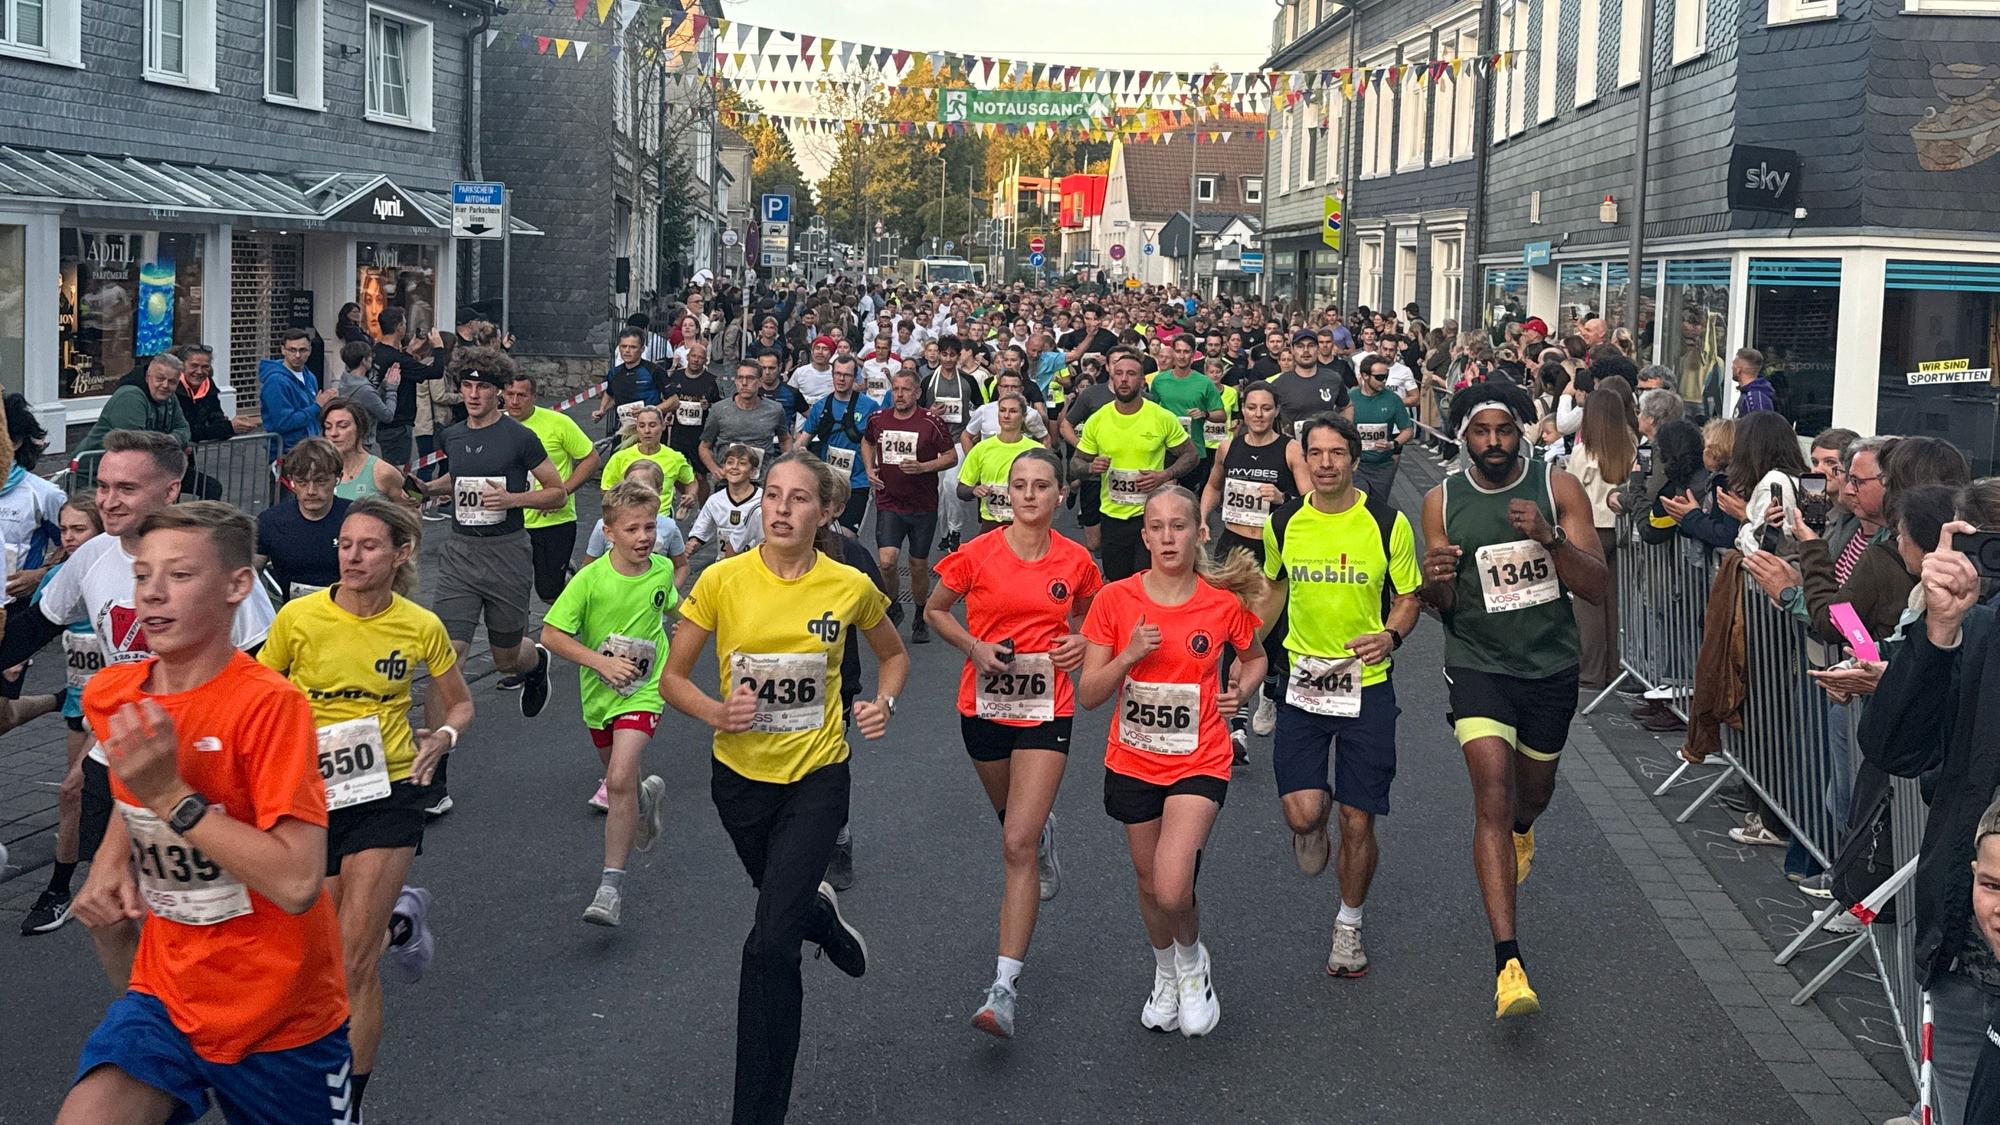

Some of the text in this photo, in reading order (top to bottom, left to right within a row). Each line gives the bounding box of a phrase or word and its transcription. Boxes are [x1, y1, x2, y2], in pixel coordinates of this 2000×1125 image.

[973, 101, 1083, 116] NOTAUSGANG
[1745, 161, 1791, 198] sky
[464, 195, 491, 204] AUTOMAT
[469, 206, 500, 214] Parkschein
[768, 197, 783, 218] P
[92, 271, 128, 281] PARFÜMERIE
[1922, 361, 1967, 371] WIR SIND
[1910, 371, 1988, 384] SPORTWETTEN
[679, 407, 700, 418] 2150
[1361, 431, 1385, 441] 2509
[885, 441, 913, 453] 2184
[1228, 468, 1278, 479] HYVIBES
[1112, 480, 1141, 492] 233
[1227, 492, 1263, 511] 2591
[1292, 565, 1369, 584] Mobile
[1487, 558, 1548, 587] 1345
[1490, 593, 1520, 603] VOSS
[807, 611, 841, 642] afg
[67, 648, 106, 670] 208
[375, 650, 407, 680] afg
[985, 673, 1046, 695] 2376
[1296, 669, 1353, 693] 2404
[982, 702, 1012, 711] VOSS
[1292, 693, 1320, 706] VOSS
[1126, 700, 1190, 728] 2556
[1124, 728, 1152, 743] VOSS
